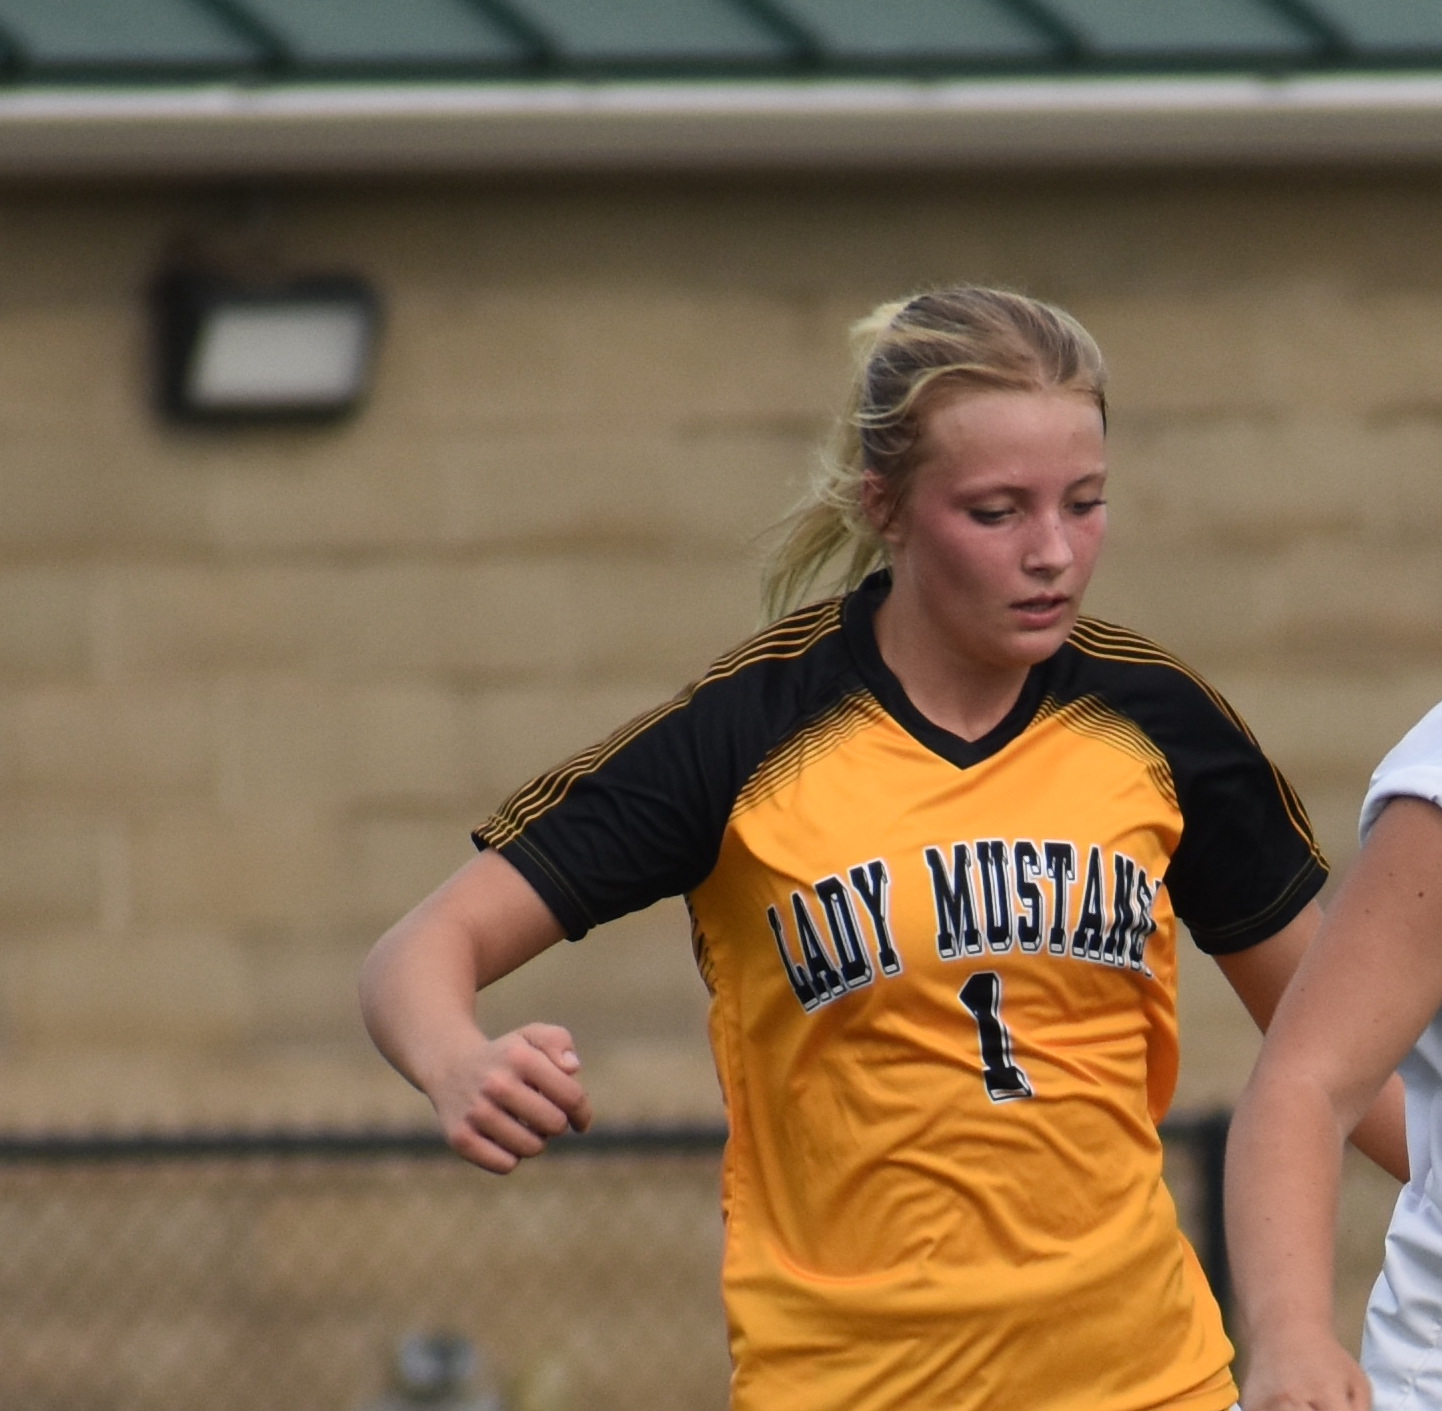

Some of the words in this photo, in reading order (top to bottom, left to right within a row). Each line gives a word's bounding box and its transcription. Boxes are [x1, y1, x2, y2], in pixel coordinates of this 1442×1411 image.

[767, 857, 901, 1013] LADY
[923, 839, 1163, 979] MUSTANG
[958, 971, 1033, 1104] 1
